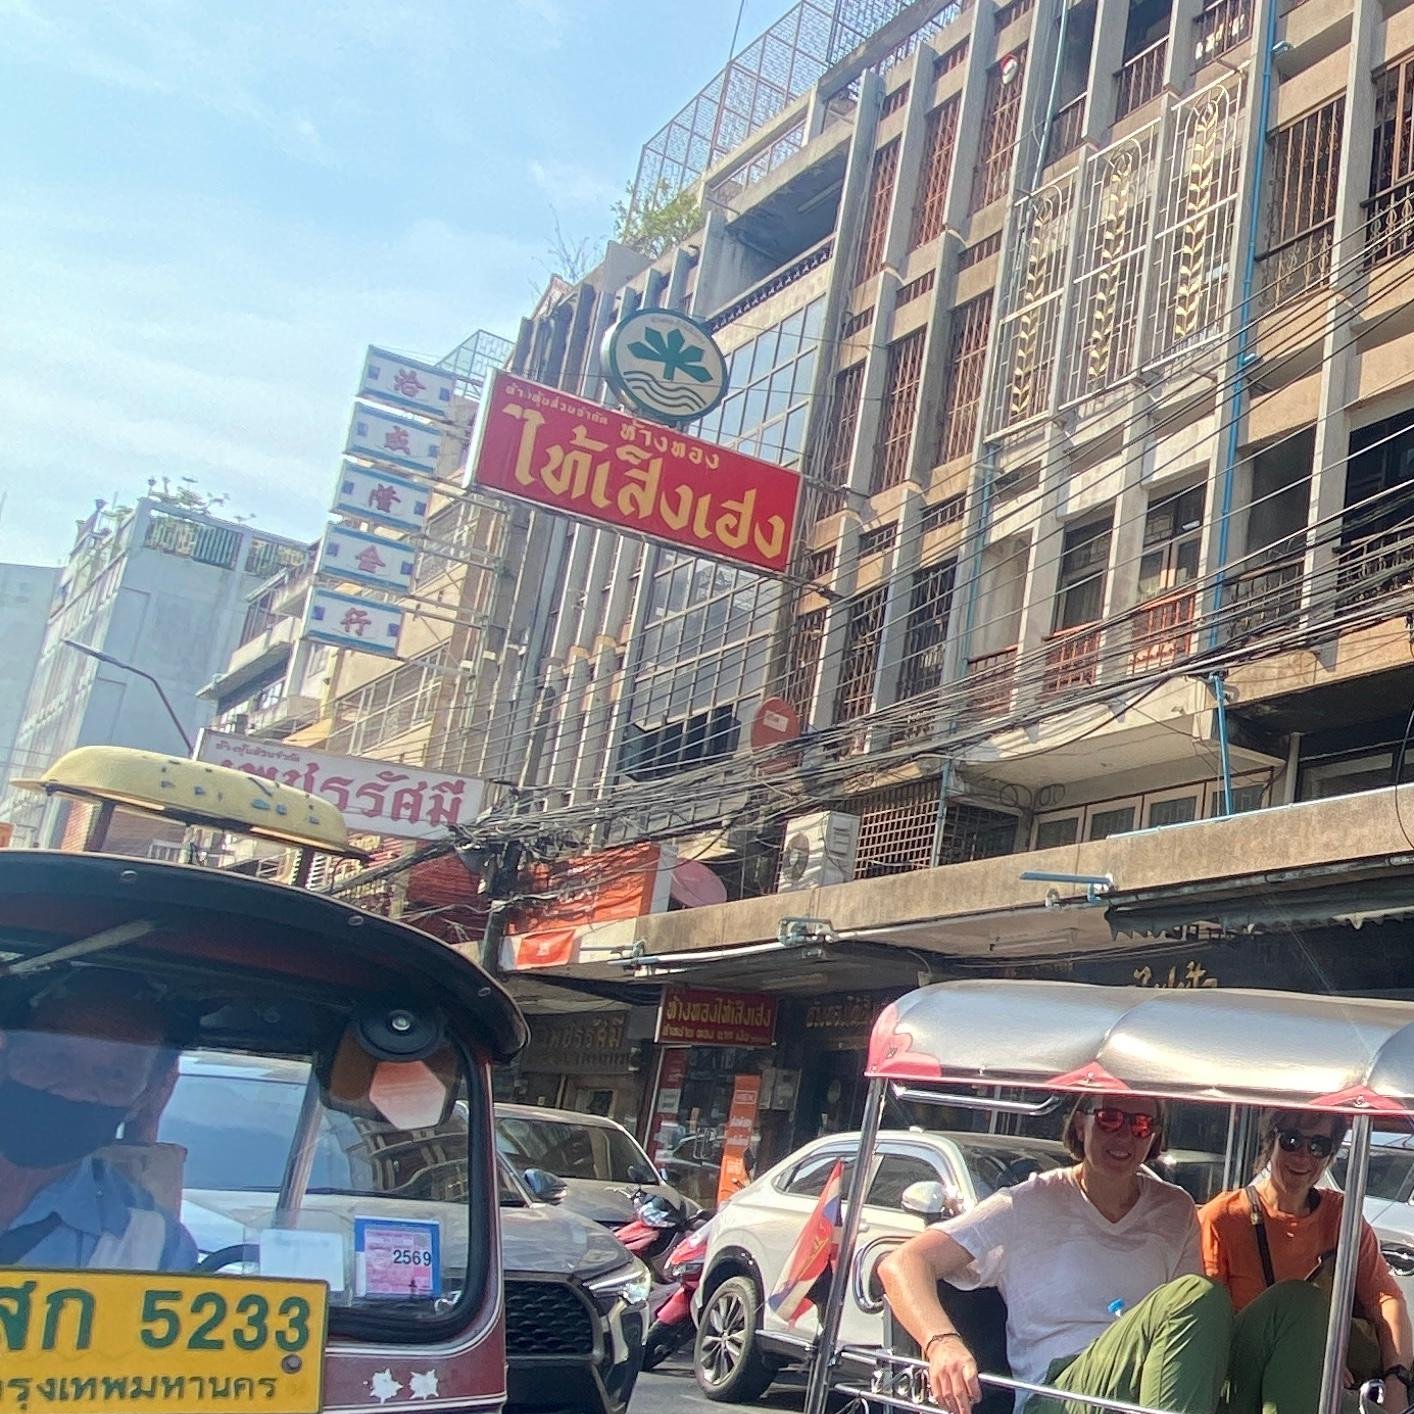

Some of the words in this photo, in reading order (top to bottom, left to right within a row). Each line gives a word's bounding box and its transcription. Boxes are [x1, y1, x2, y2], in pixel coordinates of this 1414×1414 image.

[619, 420, 721, 470] ห้างทอง
[393, 1249, 432, 1267] 2569
[140, 1289, 311, 1351] 5233
[0, 1374, 278, 1411] รุงเทพมหานคร
